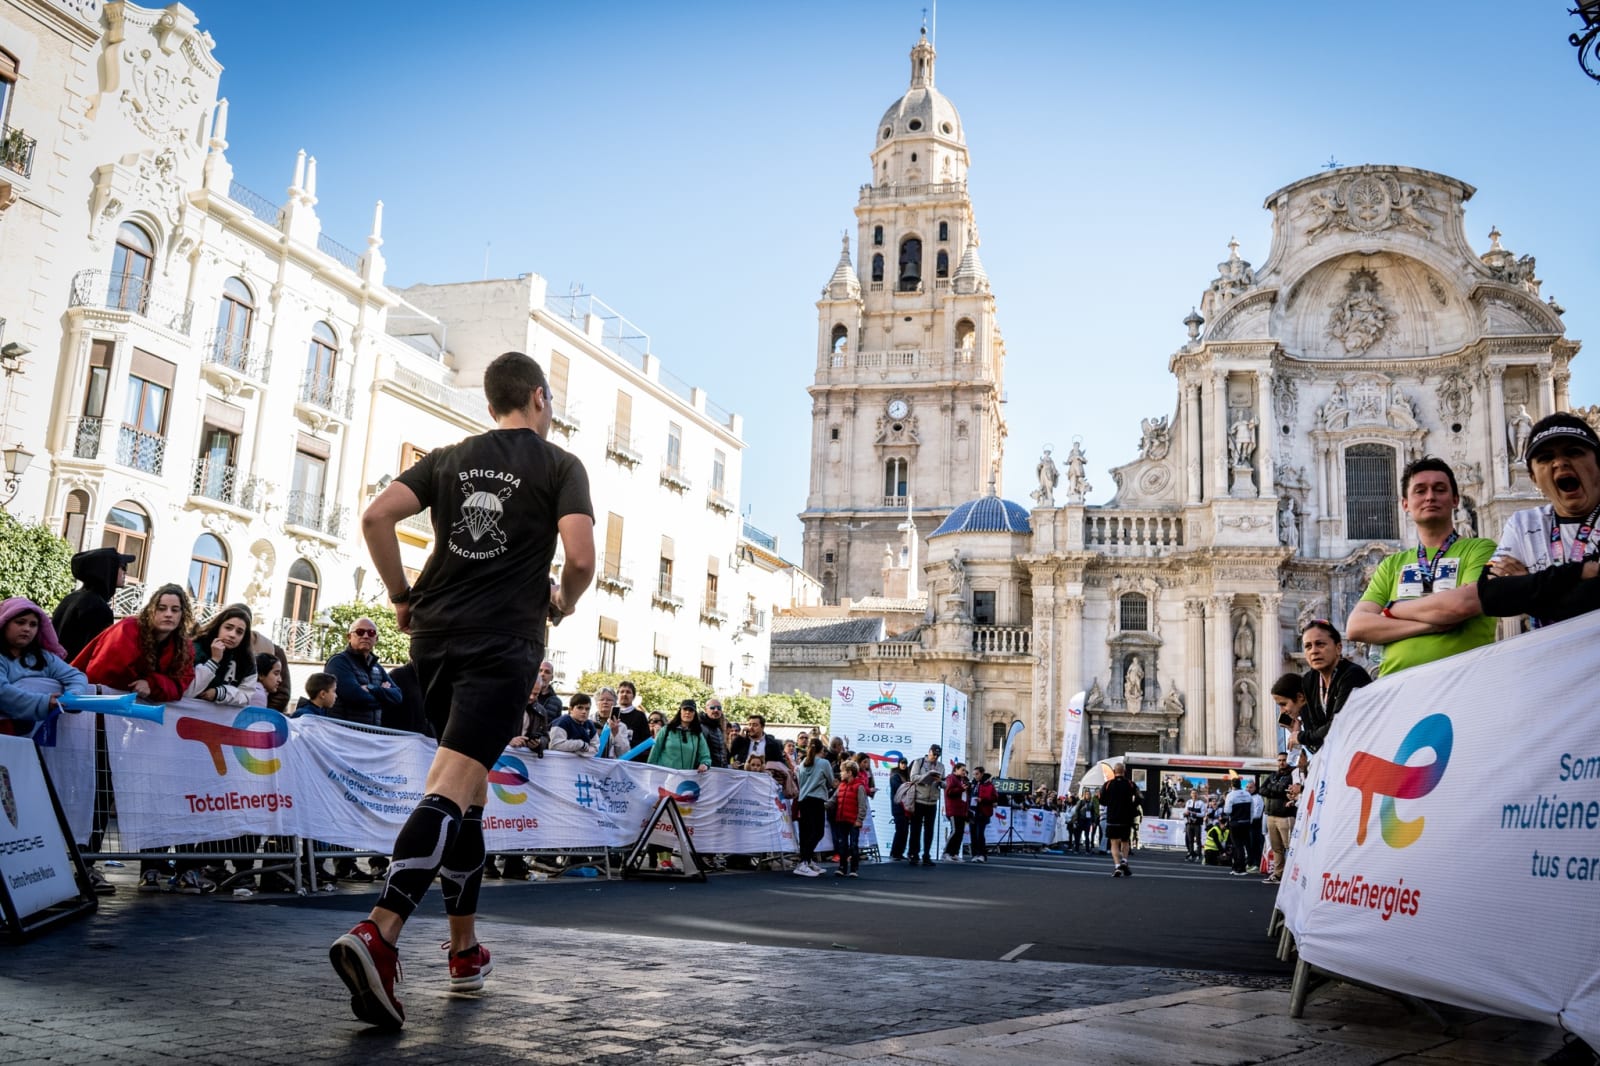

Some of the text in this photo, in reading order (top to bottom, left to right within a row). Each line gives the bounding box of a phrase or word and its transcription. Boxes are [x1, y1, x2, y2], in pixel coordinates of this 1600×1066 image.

[458, 468, 521, 488] BRIGADA
[448, 537, 508, 560] ARACAIDISTA
[857, 733, 912, 744] 2:08:35
[1500, 794, 1600, 830] multiene
[1532, 850, 1560, 878] tus
[1320, 872, 1421, 922] TotalEnergies
